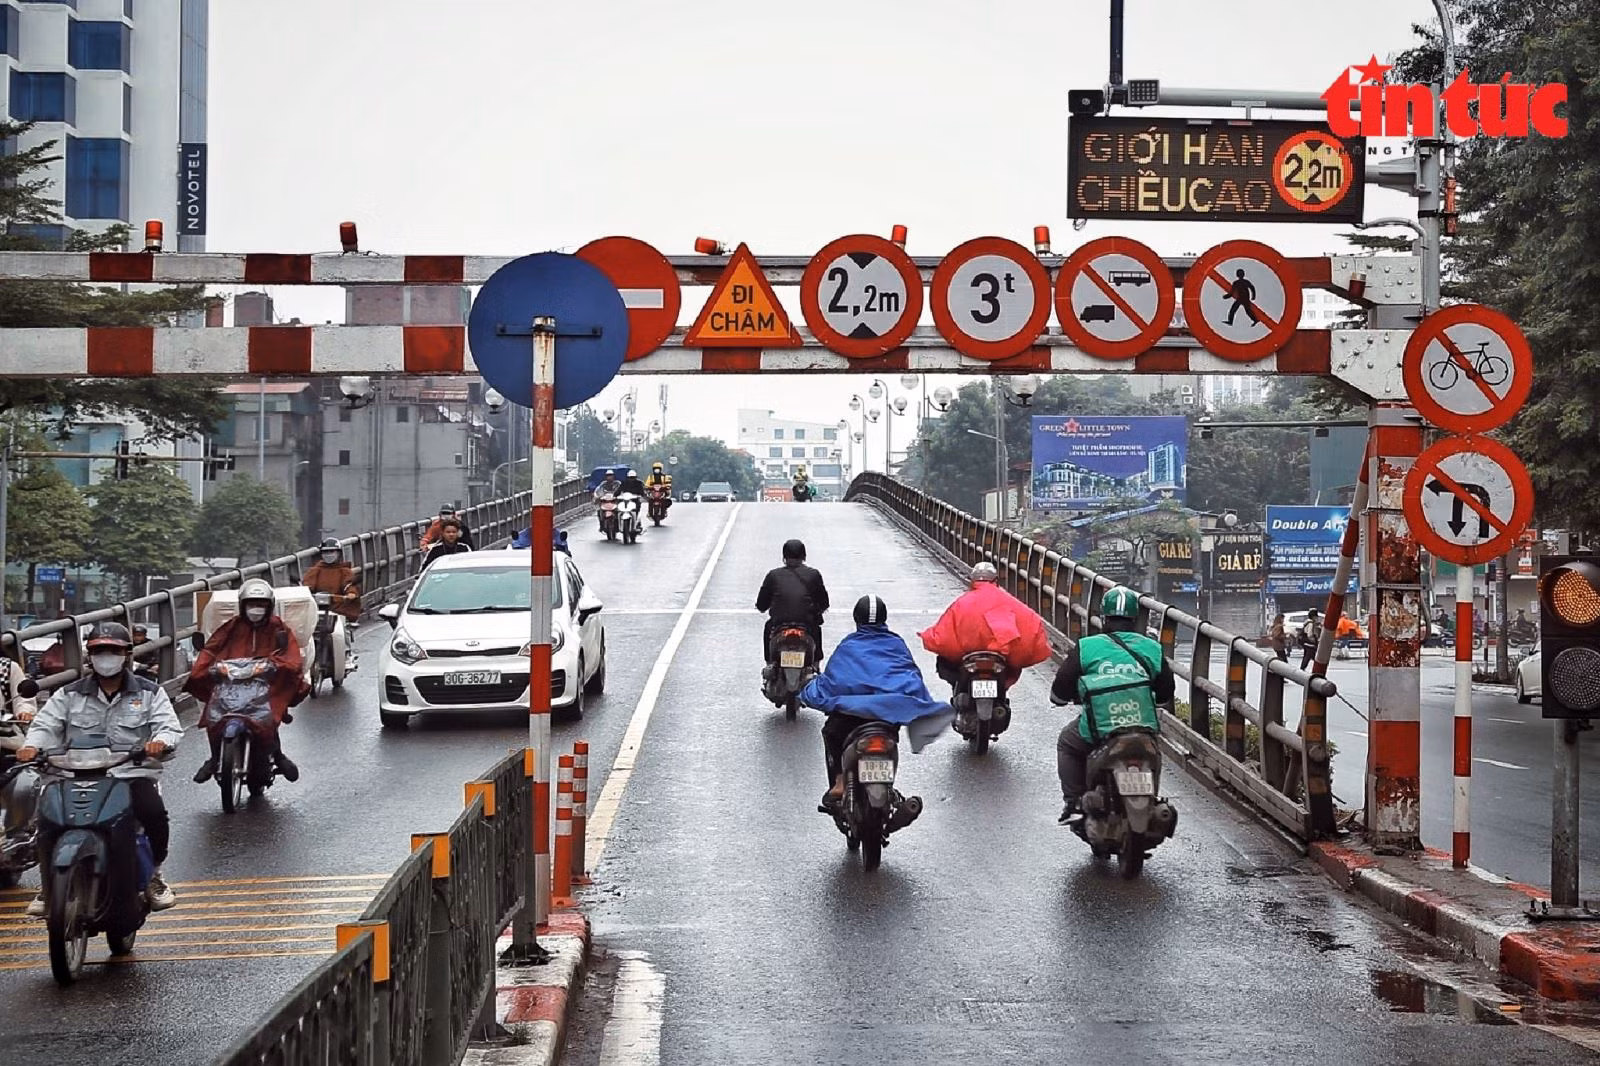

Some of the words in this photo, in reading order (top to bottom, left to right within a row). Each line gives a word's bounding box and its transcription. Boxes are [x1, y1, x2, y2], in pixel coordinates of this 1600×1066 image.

[1084, 126, 1170, 164] GIỚI
[1284, 153, 1342, 193] 2,2m
[188, 150, 200, 229] NOVOTEL
[731, 284, 754, 305] ĐI
[827, 266, 900, 318] 2,2m
[710, 308, 775, 336] CHẬM
[1039, 424, 1065, 432] GREEN
[1079, 424, 1106, 432] LITTLE
[1107, 424, 1131, 432] TOWN
[1272, 519, 1319, 530] Double
[1159, 538, 1176, 558] GIÁ
[1218, 550, 1242, 571] GIÁ
[1306, 581, 1333, 591] Doubl
[1109, 700, 1140, 714] Grab
[1110, 711, 1142, 727] Food
